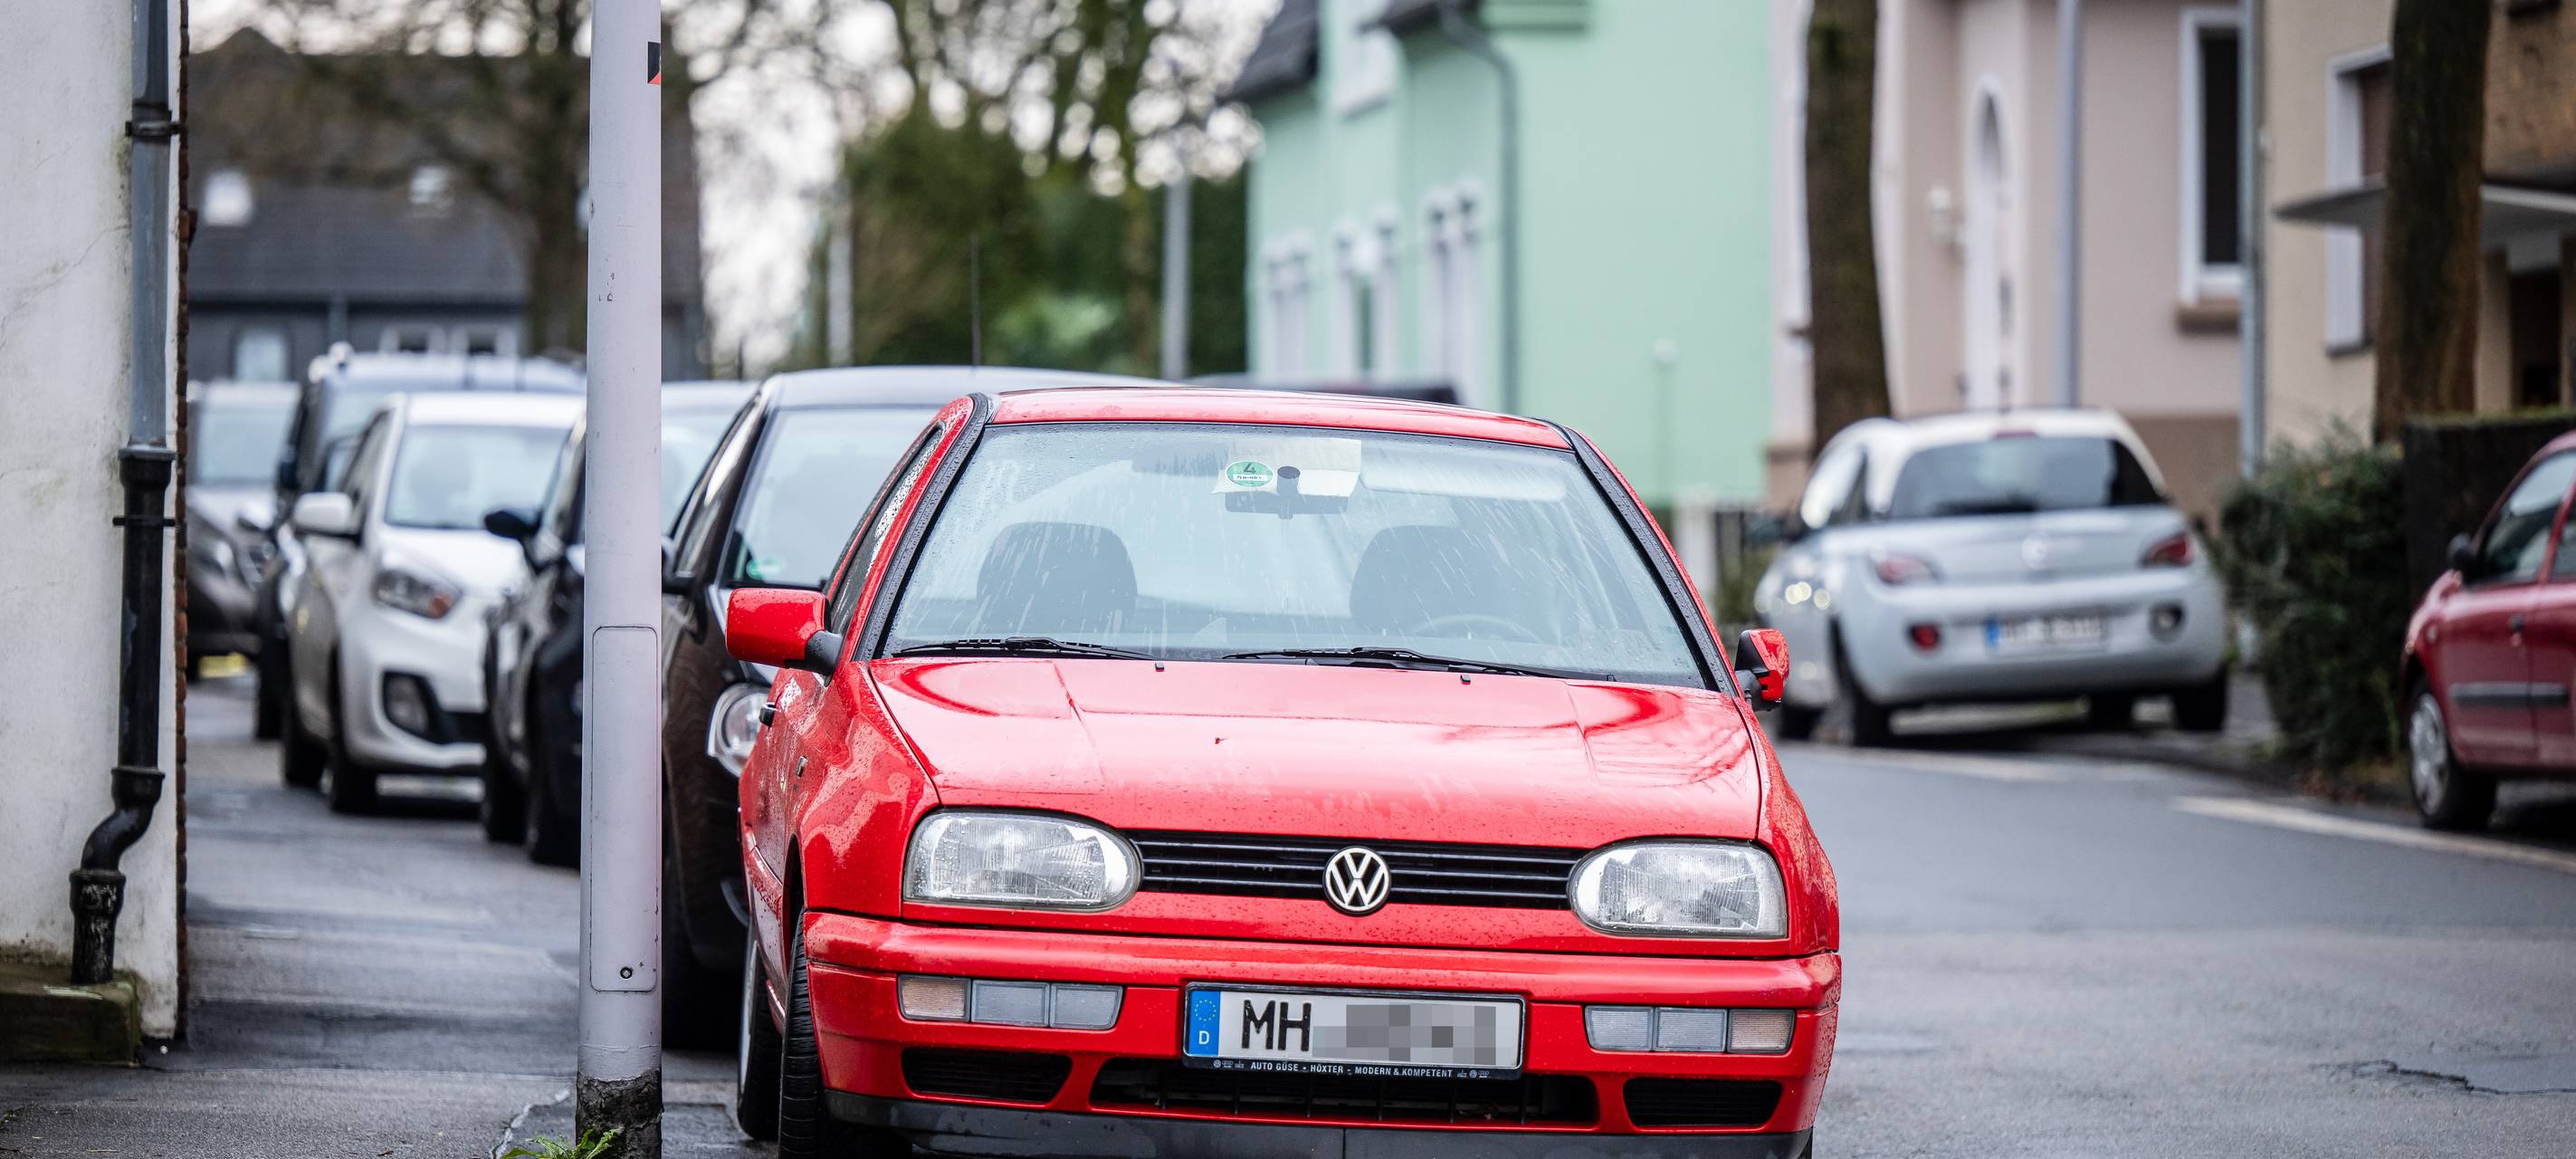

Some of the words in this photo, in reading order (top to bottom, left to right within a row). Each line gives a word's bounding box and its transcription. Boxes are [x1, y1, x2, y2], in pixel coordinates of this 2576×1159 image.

[1244, 462, 1257, 474] 4
[1327, 849, 1388, 909] VW
[1241, 999, 1312, 1052] MH
[1198, 1030, 1210, 1045] D
[1250, 1061, 1273, 1070] AUTO
[1275, 1061, 1299, 1072] GÜSE
[1310, 1063, 1343, 1074] HÖXTER
[1355, 1066, 1391, 1076] MODERN
[1402, 1068, 1454, 1078] KOMPETENT
